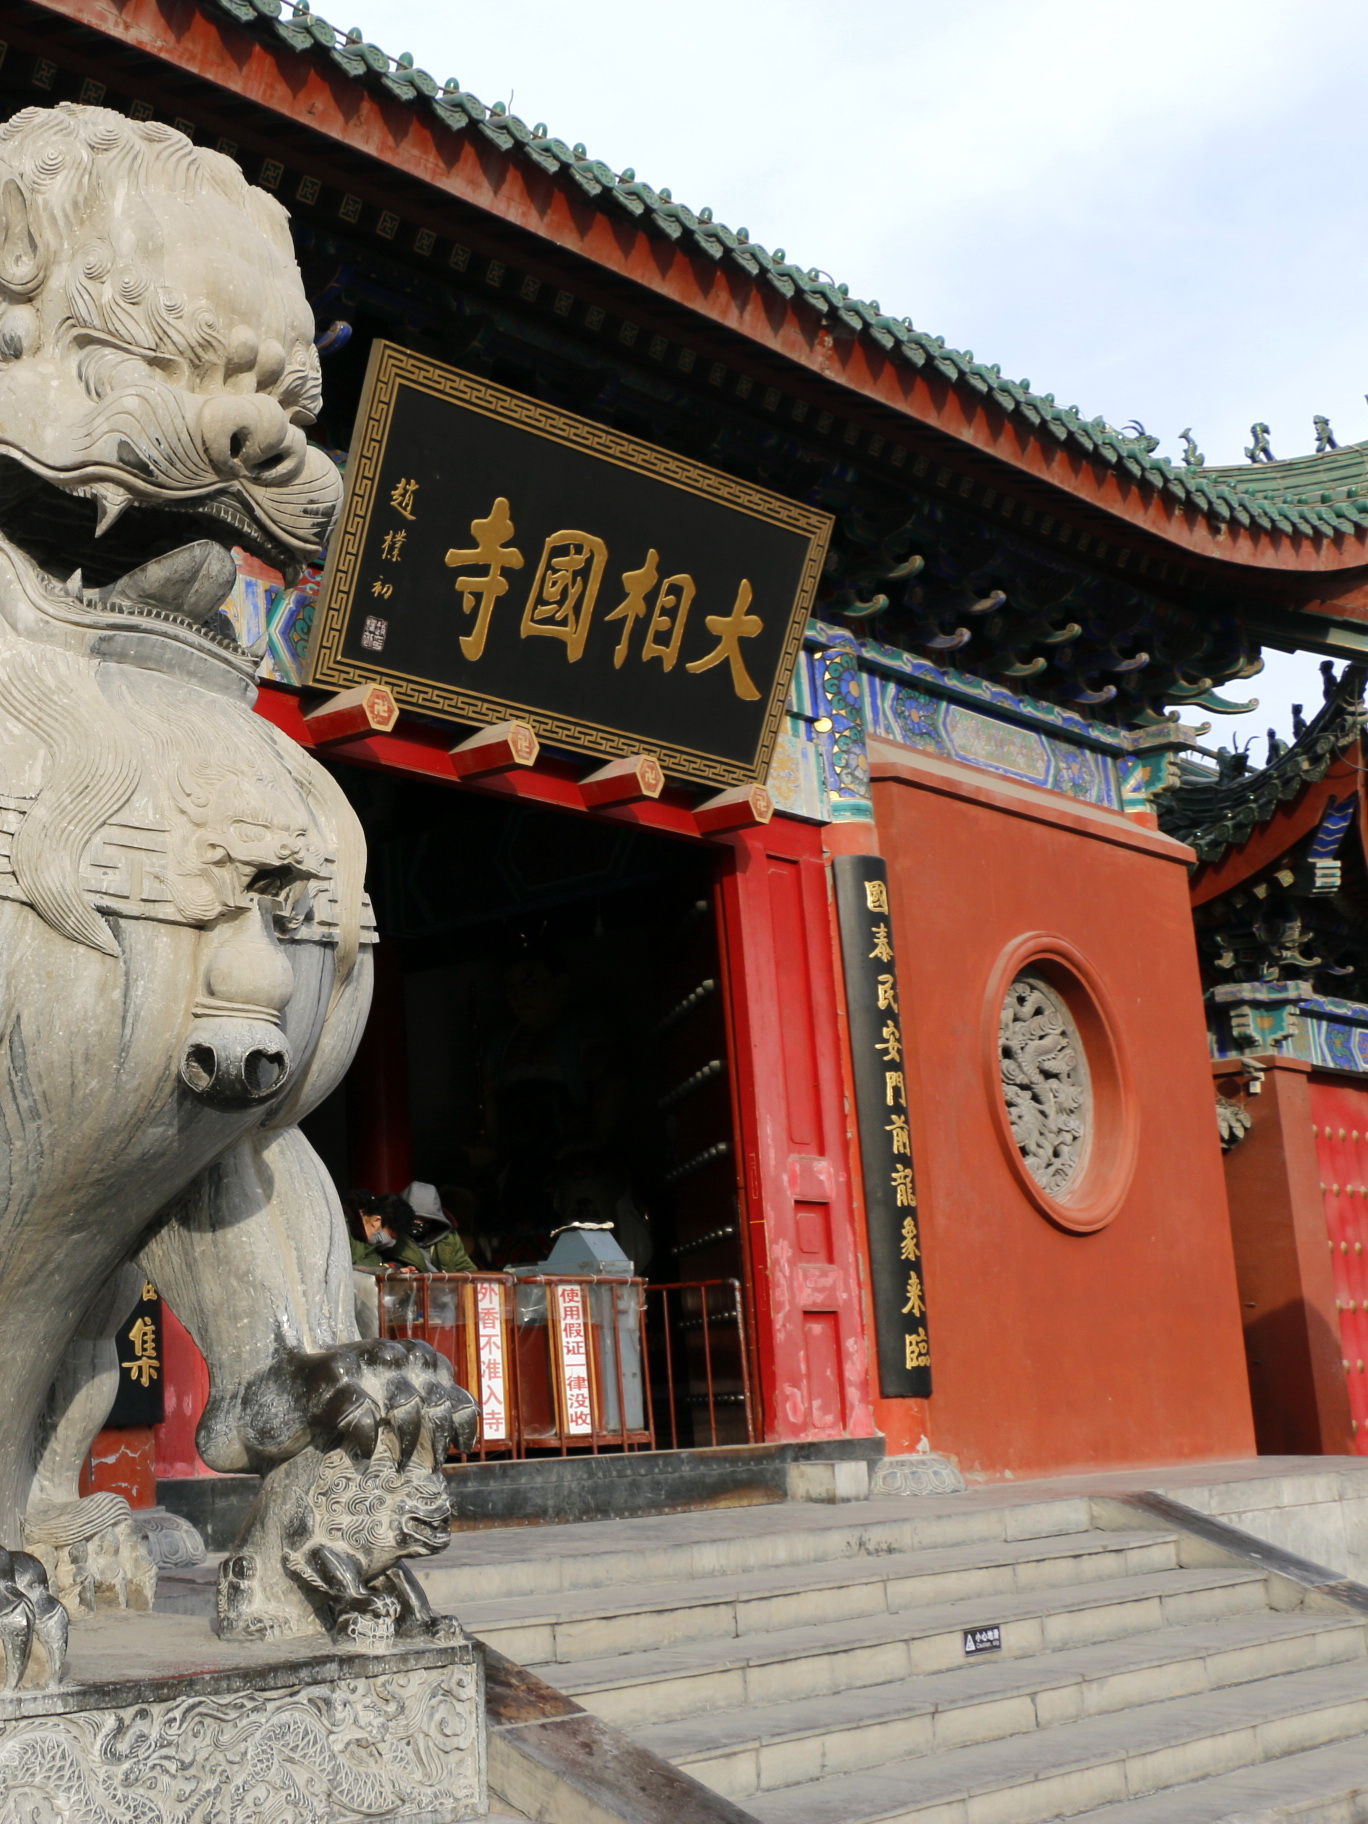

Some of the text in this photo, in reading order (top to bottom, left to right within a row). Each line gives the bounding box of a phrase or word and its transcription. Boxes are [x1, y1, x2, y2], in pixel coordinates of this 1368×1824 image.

[445, 497, 763, 700] 大相國寺
[477, 1281, 503, 1432] 外香不准入寺
[560, 1288, 591, 1426] 使用假证一律没收
